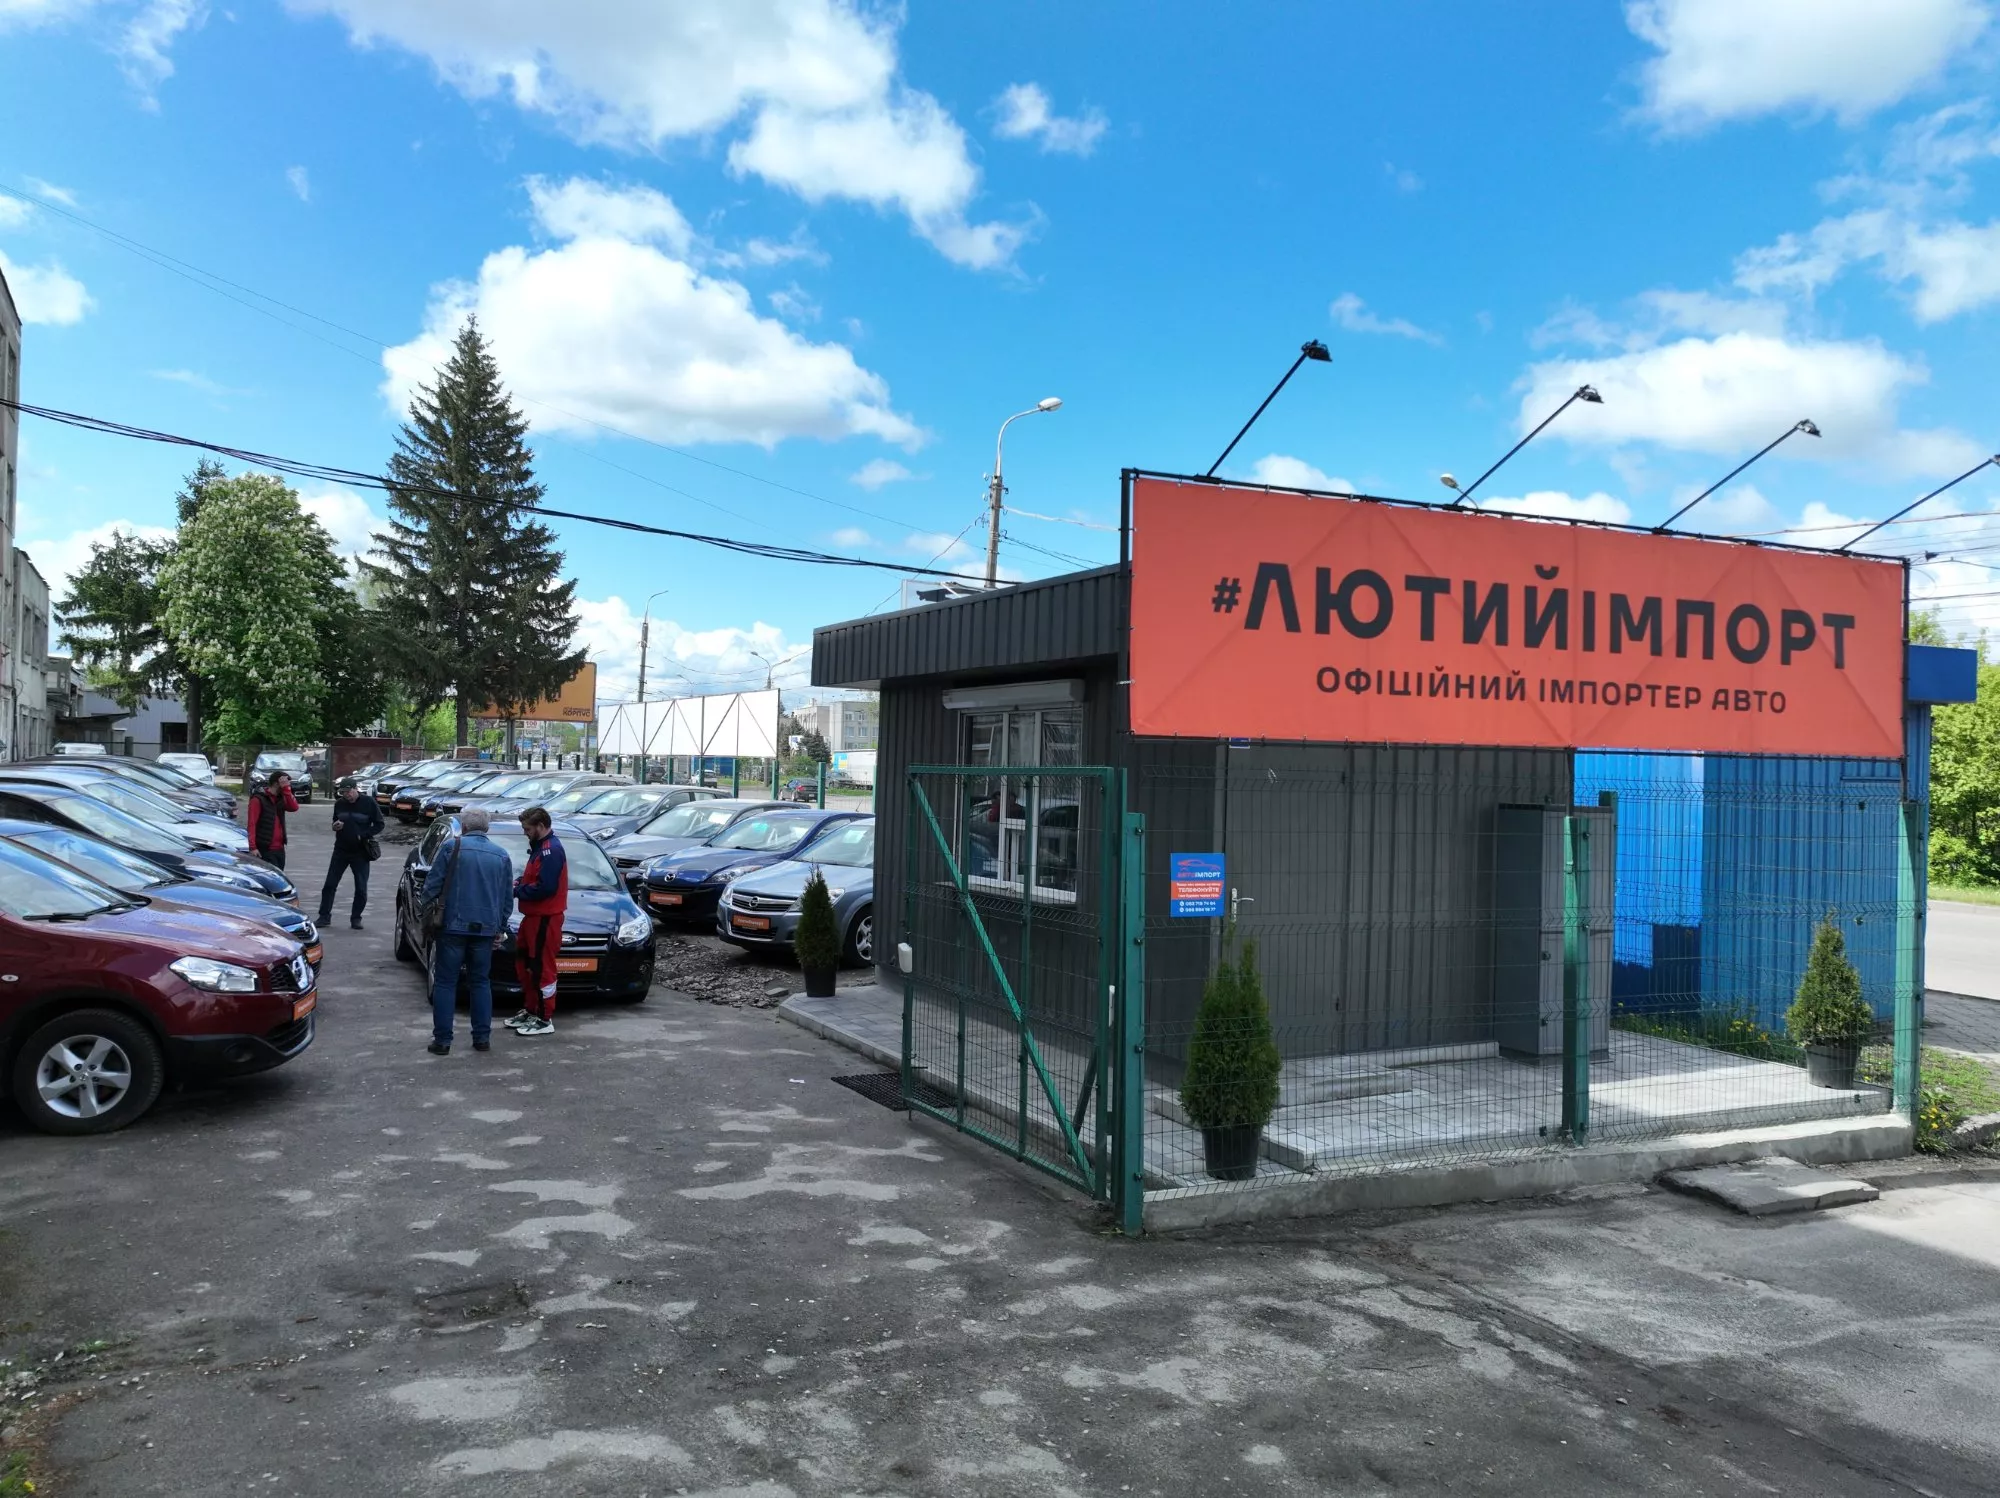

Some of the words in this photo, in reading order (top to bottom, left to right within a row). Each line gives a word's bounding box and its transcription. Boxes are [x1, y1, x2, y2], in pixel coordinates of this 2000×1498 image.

[1212, 562, 1855, 669] #ЛЮТИЙІМПОРТ
[1316, 665, 1526, 701] ОФІЦІЙНИЙ
[1539, 678, 1701, 708] ІМПОРТЕР
[1712, 688, 1786, 713] АВТО
